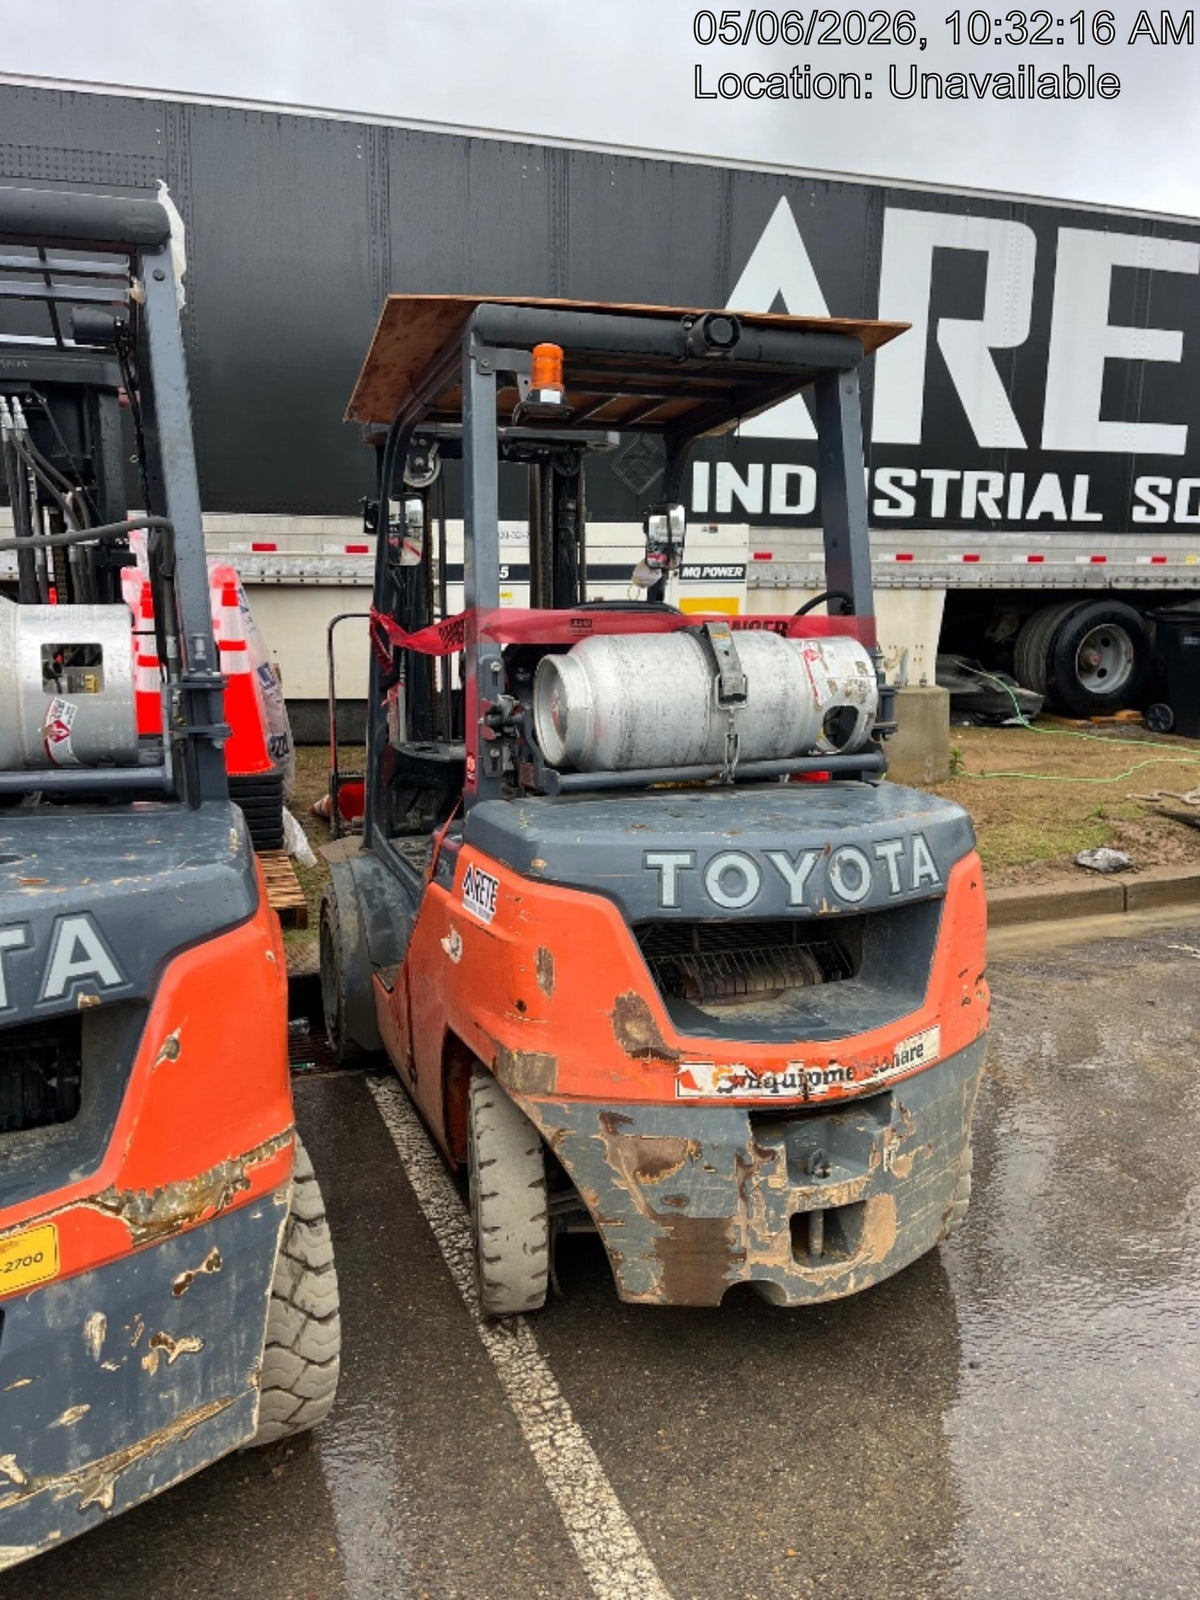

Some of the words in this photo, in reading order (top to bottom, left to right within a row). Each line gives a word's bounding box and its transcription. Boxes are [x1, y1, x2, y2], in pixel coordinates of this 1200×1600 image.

[692, 461, 1103, 522] INDSTRIAL
[682, 566, 701, 579] MQ
[702, 566, 744, 577] POWER
[645, 833, 942, 909] TOYOTA
